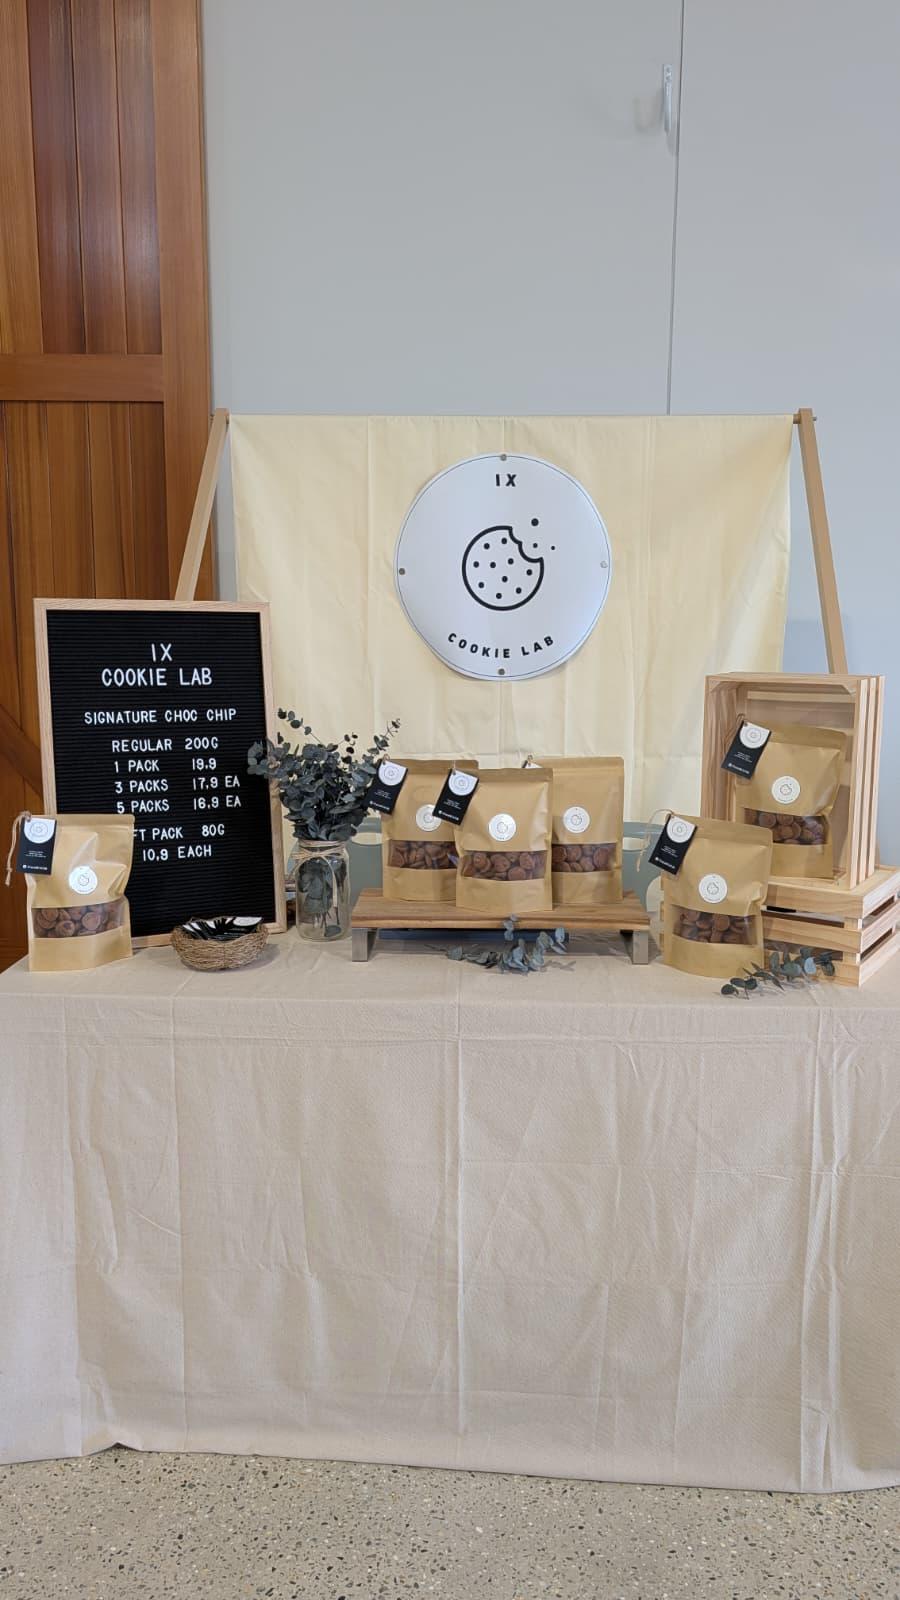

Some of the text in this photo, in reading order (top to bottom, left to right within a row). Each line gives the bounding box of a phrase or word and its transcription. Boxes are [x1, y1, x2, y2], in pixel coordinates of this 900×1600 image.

[495, 473, 518, 488] IX
[150, 643, 173, 662] IX
[447, 632, 554, 659] COOKIE LAB
[101, 667, 213, 687] COOKIE LAB
[84, 708, 237, 725] SIGNATURE CHOC CHIP
[111, 736, 219, 753] REGULAR 200G
[113, 758, 217, 774] 1 PACK 19.9
[114, 775, 241, 794] 3 PACKS 17.9 EA
[116, 794, 242, 814] 5 PACKS 16.9 EA
[151, 826, 184, 841] PACK
[201, 823, 225, 837] 80G
[142, 844, 212, 862] 10.9 EACH
